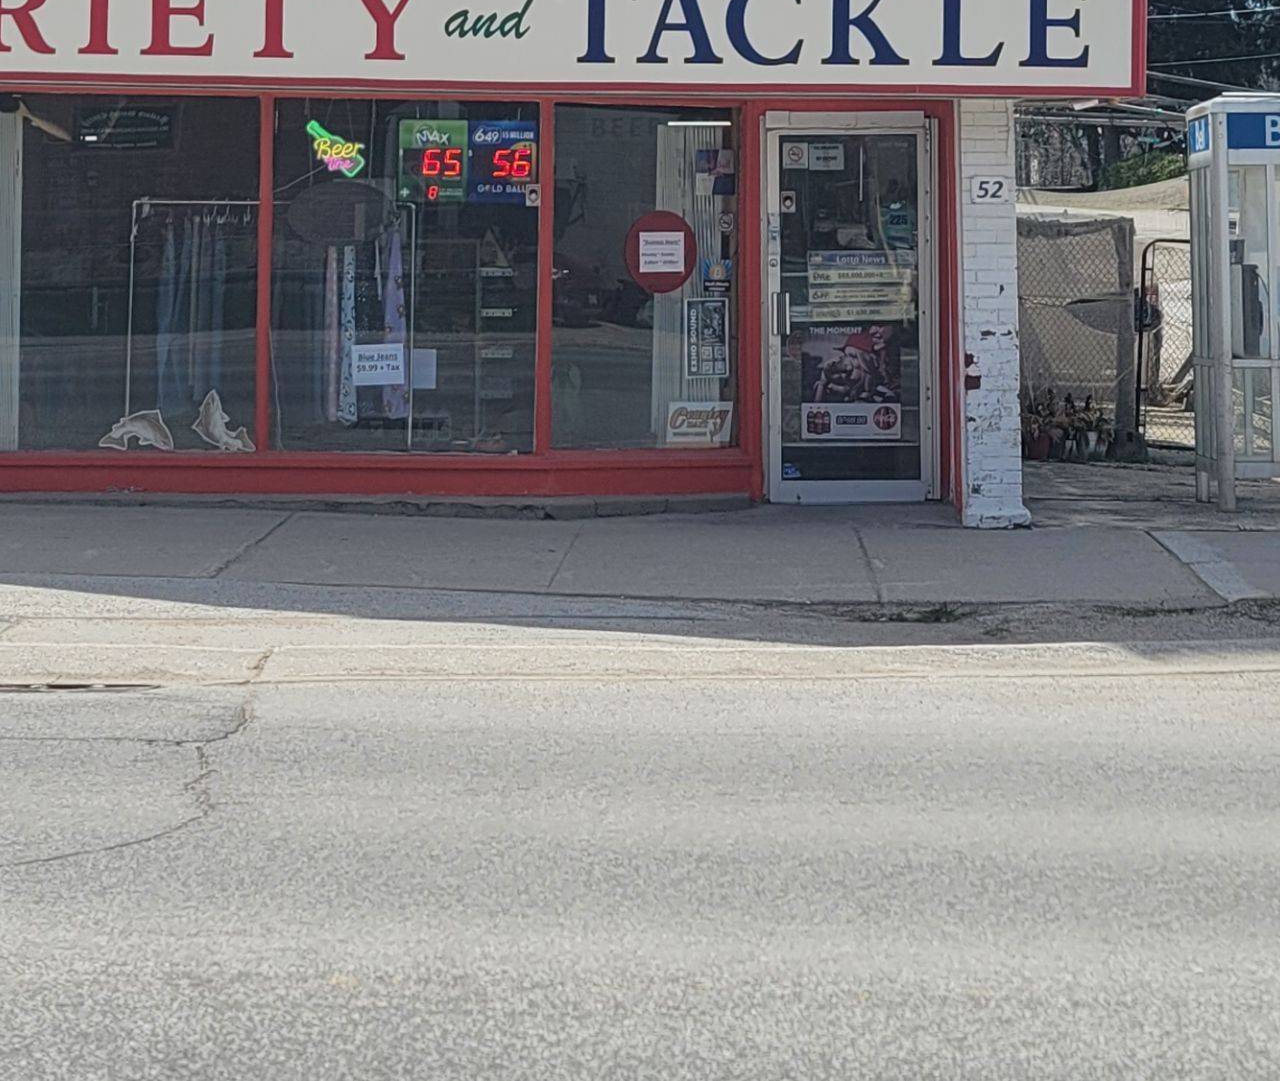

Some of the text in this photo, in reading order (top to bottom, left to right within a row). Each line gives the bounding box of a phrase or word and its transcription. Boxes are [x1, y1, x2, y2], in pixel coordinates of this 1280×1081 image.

[313, 138, 366, 160] Beer
[422, 148, 462, 177] 65
[492, 149, 531, 177] 56
[506, 184, 526, 193] BALL
[976, 180, 1004, 199] 52
[836, 255, 886, 265] Lotto News
[689, 308, 697, 343] SOUND
[808, 327, 862, 335] THE MOMENT
[669, 406, 729, 437] Country
